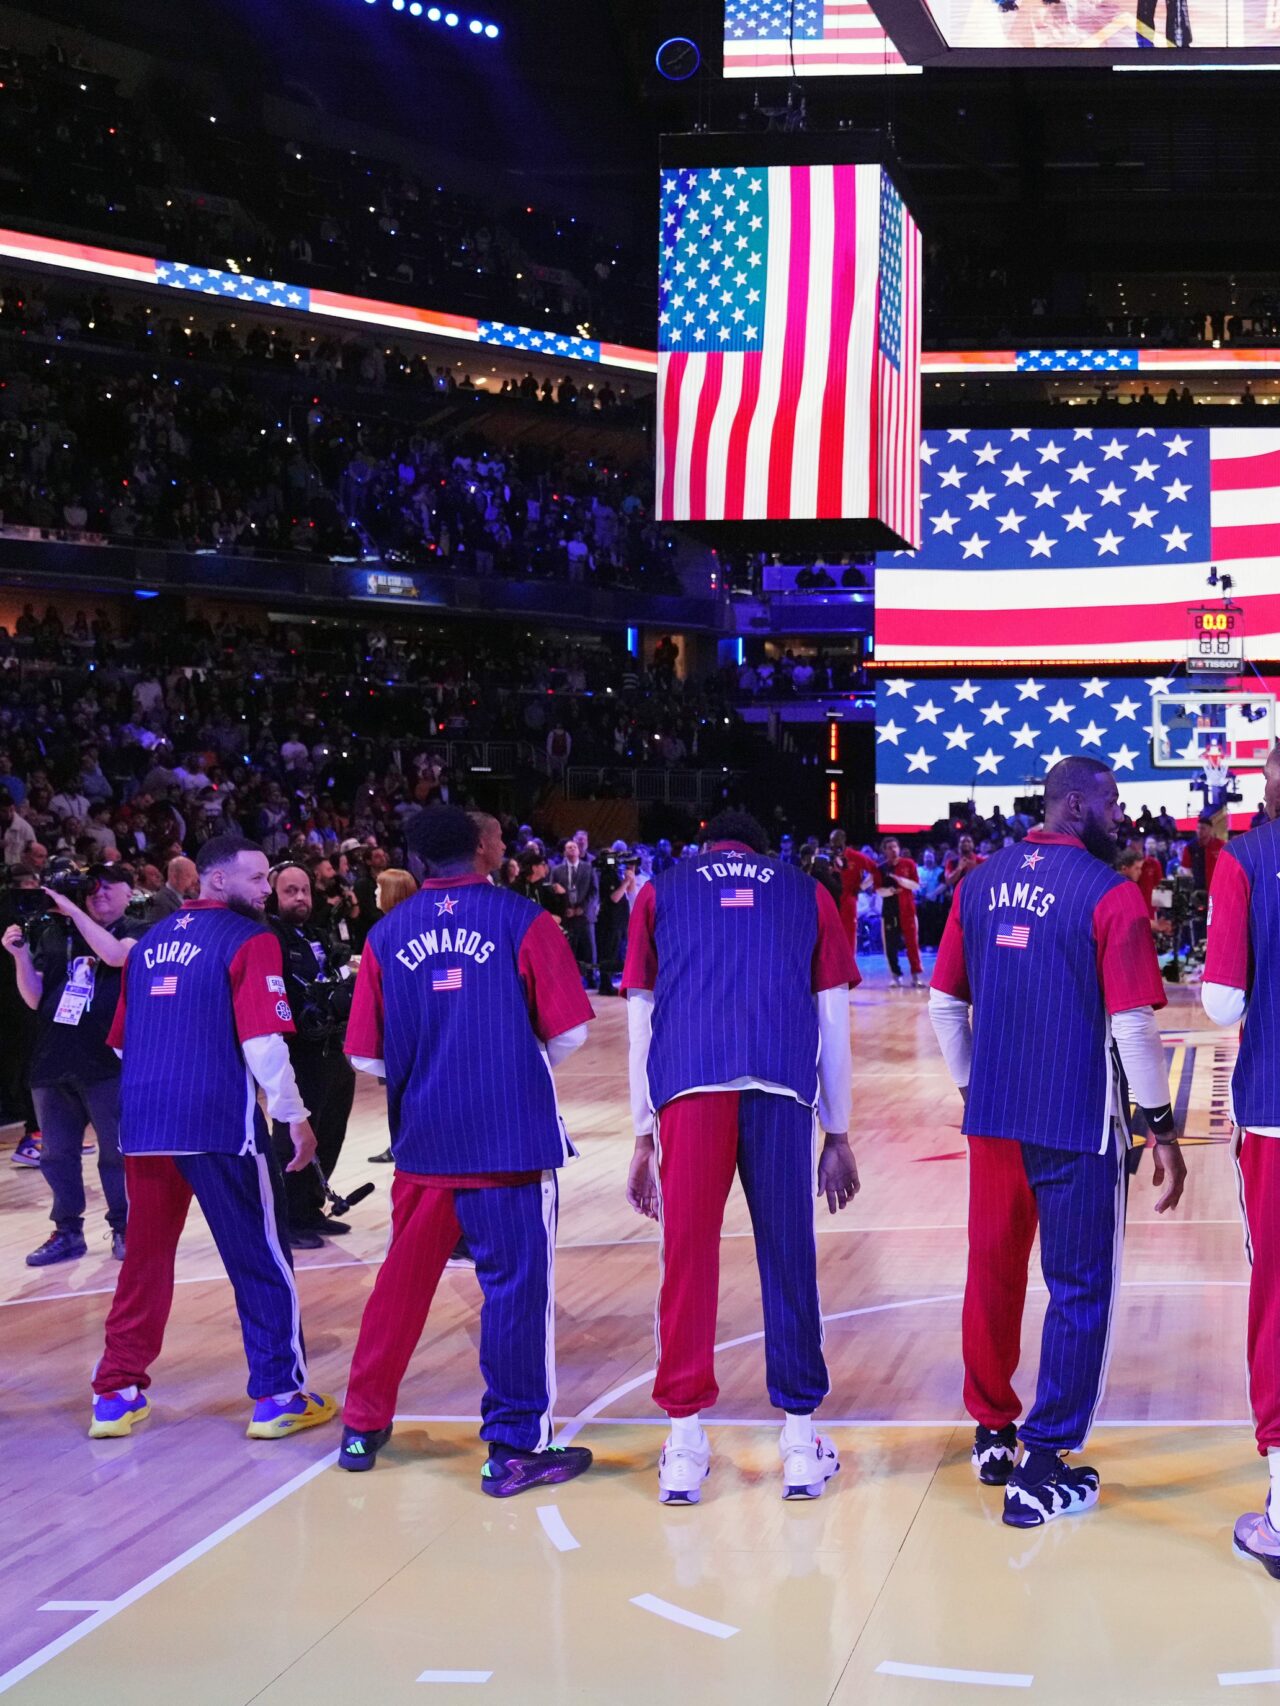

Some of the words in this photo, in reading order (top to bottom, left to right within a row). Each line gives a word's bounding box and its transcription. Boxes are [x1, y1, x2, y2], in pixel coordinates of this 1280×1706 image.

[1204, 661, 1240, 669] TISSOT
[696, 862, 775, 884] TOWNS
[988, 882, 1056, 918] JAMES
[144, 940, 202, 969] CURRY
[395, 928, 495, 972] EDWARDS
